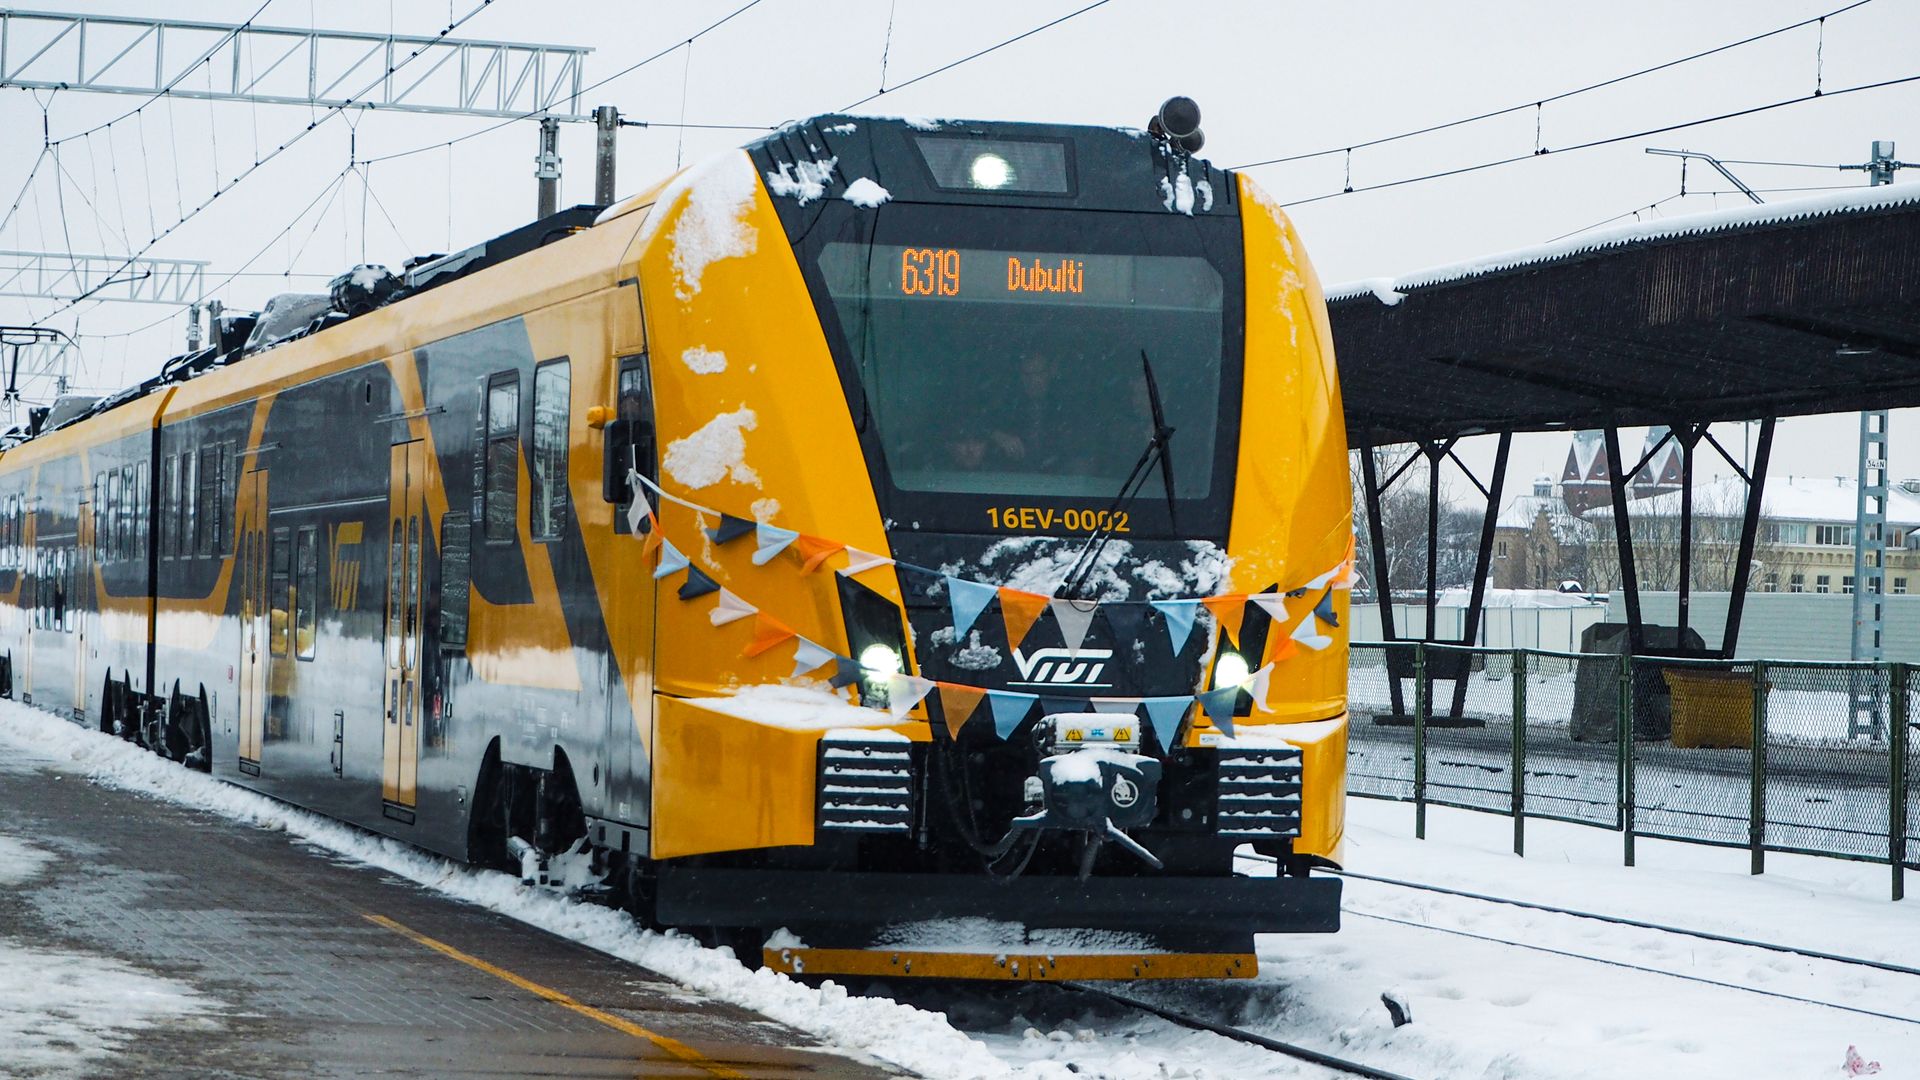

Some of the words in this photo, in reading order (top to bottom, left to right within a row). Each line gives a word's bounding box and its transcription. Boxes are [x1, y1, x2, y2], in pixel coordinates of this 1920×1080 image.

[901, 248, 961, 296] 6319
[1007, 257, 1084, 293] Dubulti
[986, 507, 1131, 532] 16EV-0002
